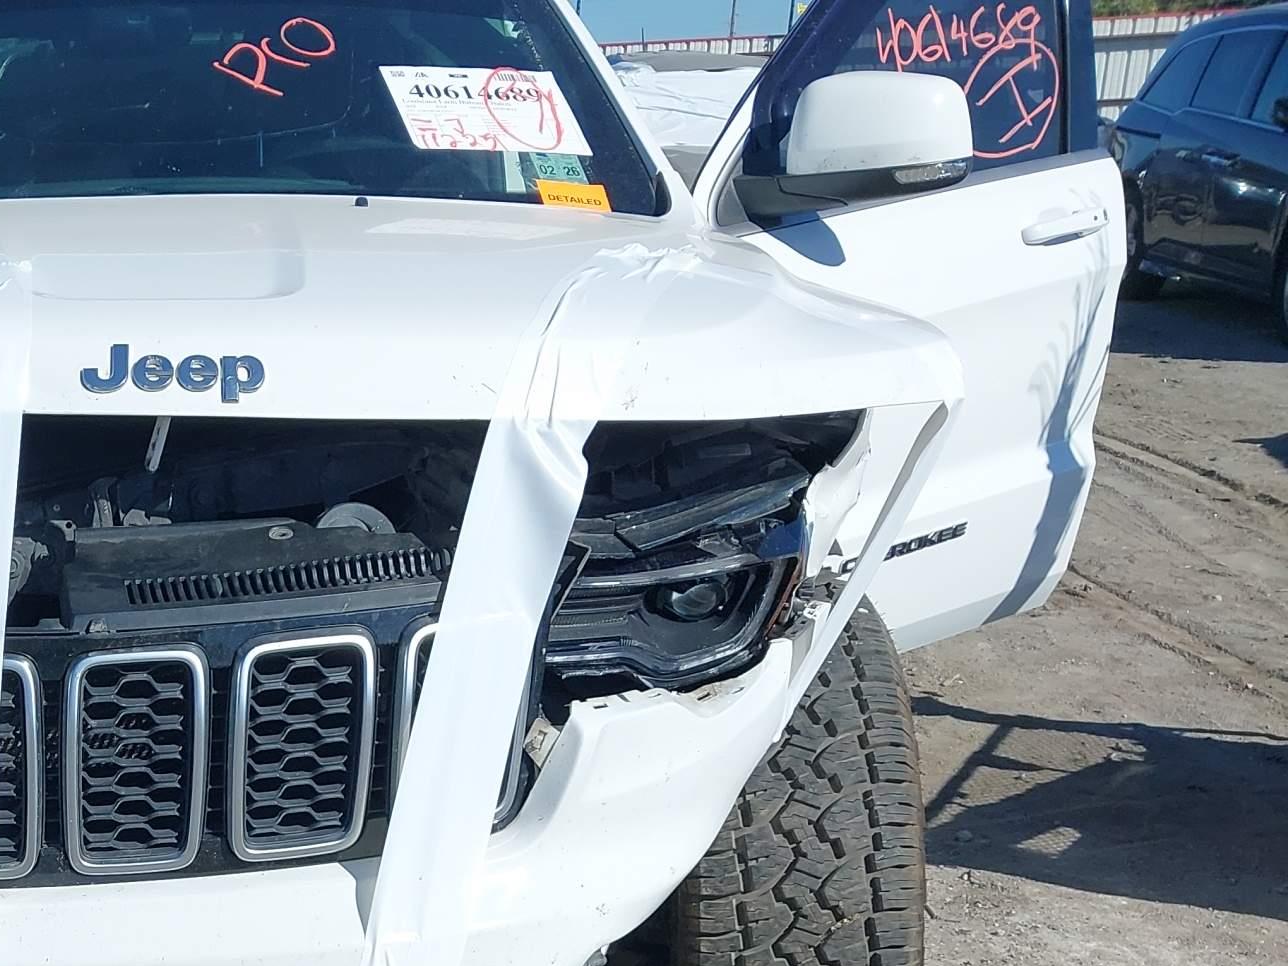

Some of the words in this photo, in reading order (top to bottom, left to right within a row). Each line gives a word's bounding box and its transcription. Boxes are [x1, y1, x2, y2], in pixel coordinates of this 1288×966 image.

[409, 83, 541, 103] 40614689
[539, 164, 556, 176] 02
[563, 166, 581, 177] 26
[547, 193, 602, 206] DETAILED
[80, 343, 265, 403] Jeep
